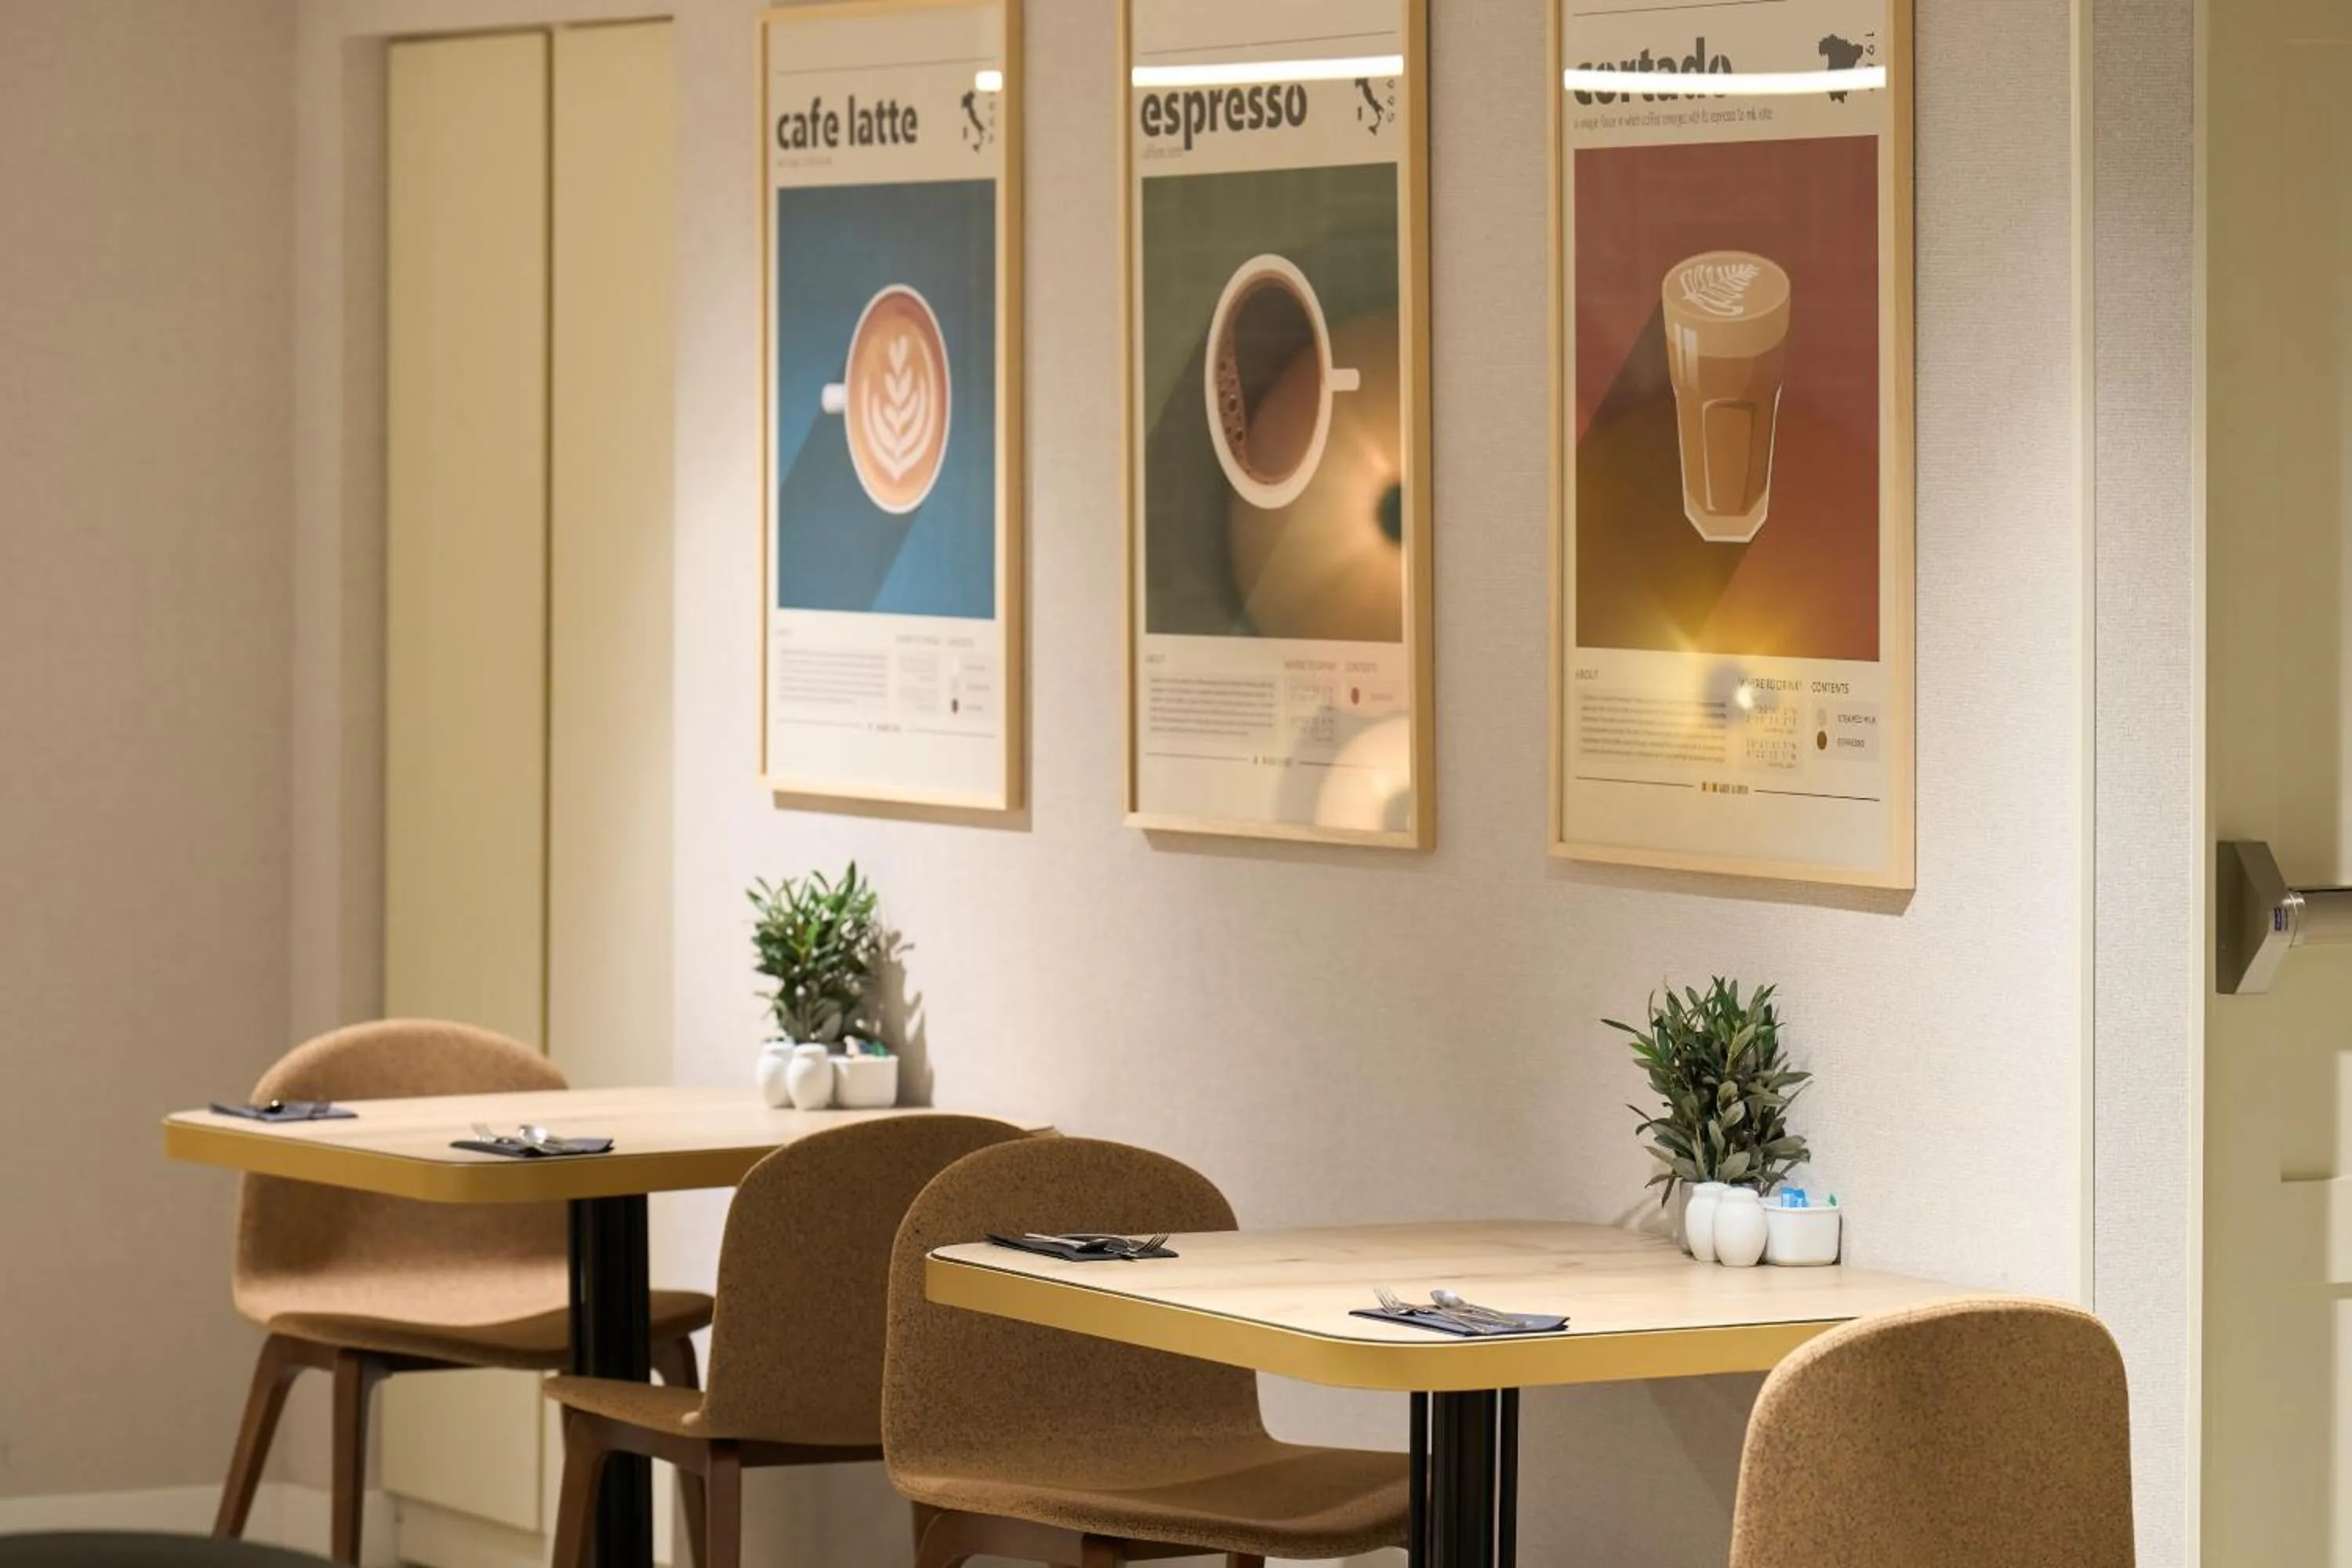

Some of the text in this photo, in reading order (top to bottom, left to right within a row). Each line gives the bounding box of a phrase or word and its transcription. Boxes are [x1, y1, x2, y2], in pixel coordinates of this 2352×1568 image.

[776, 93, 918, 151] cafe latte
[1140, 83, 1308, 151] espresso
[1811, 681, 1849, 695] CONTENTS
